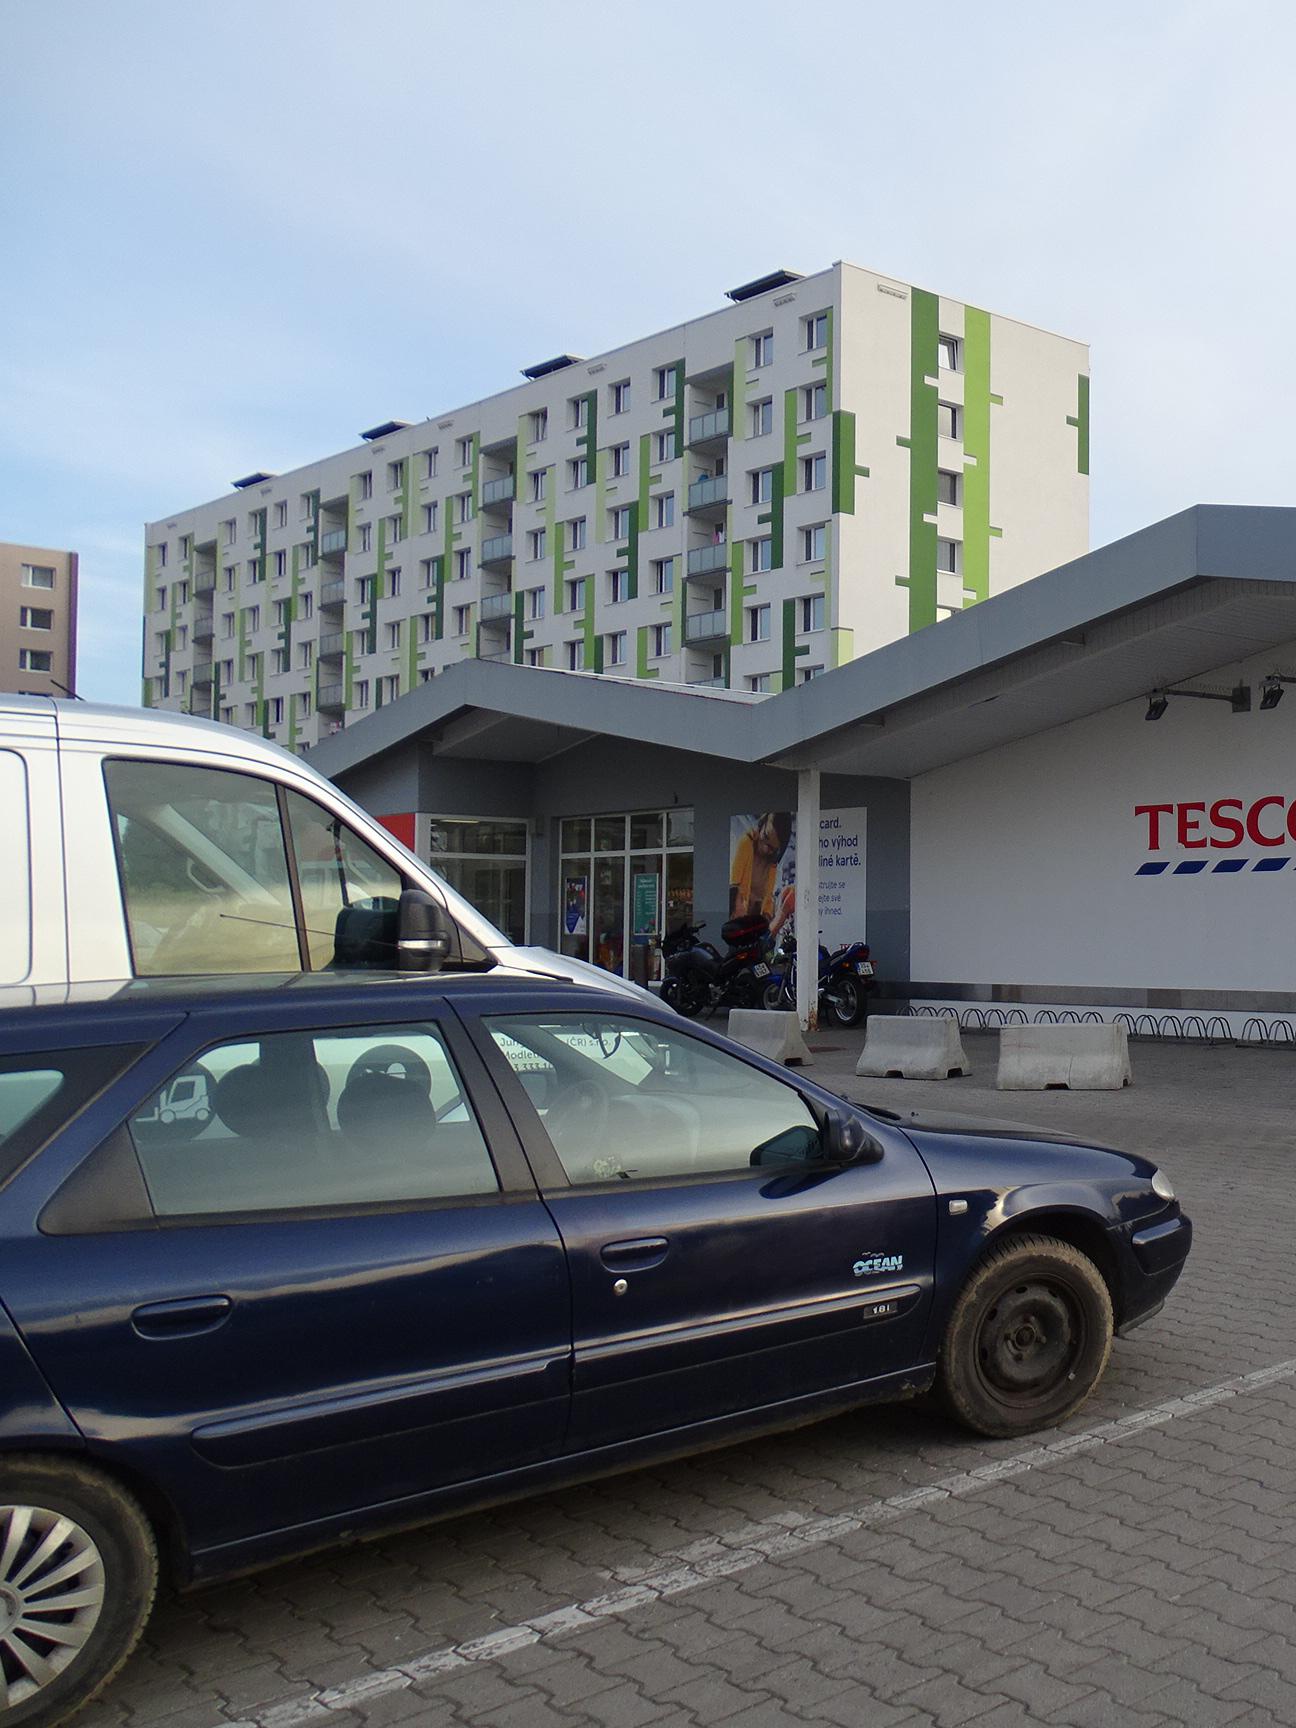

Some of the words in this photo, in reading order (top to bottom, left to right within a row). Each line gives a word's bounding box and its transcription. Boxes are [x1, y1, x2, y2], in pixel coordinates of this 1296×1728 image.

[832, 835, 858, 850] výhod
[835, 852, 861, 867] kartě.
[852, 1254, 903, 1275] OCEAN
